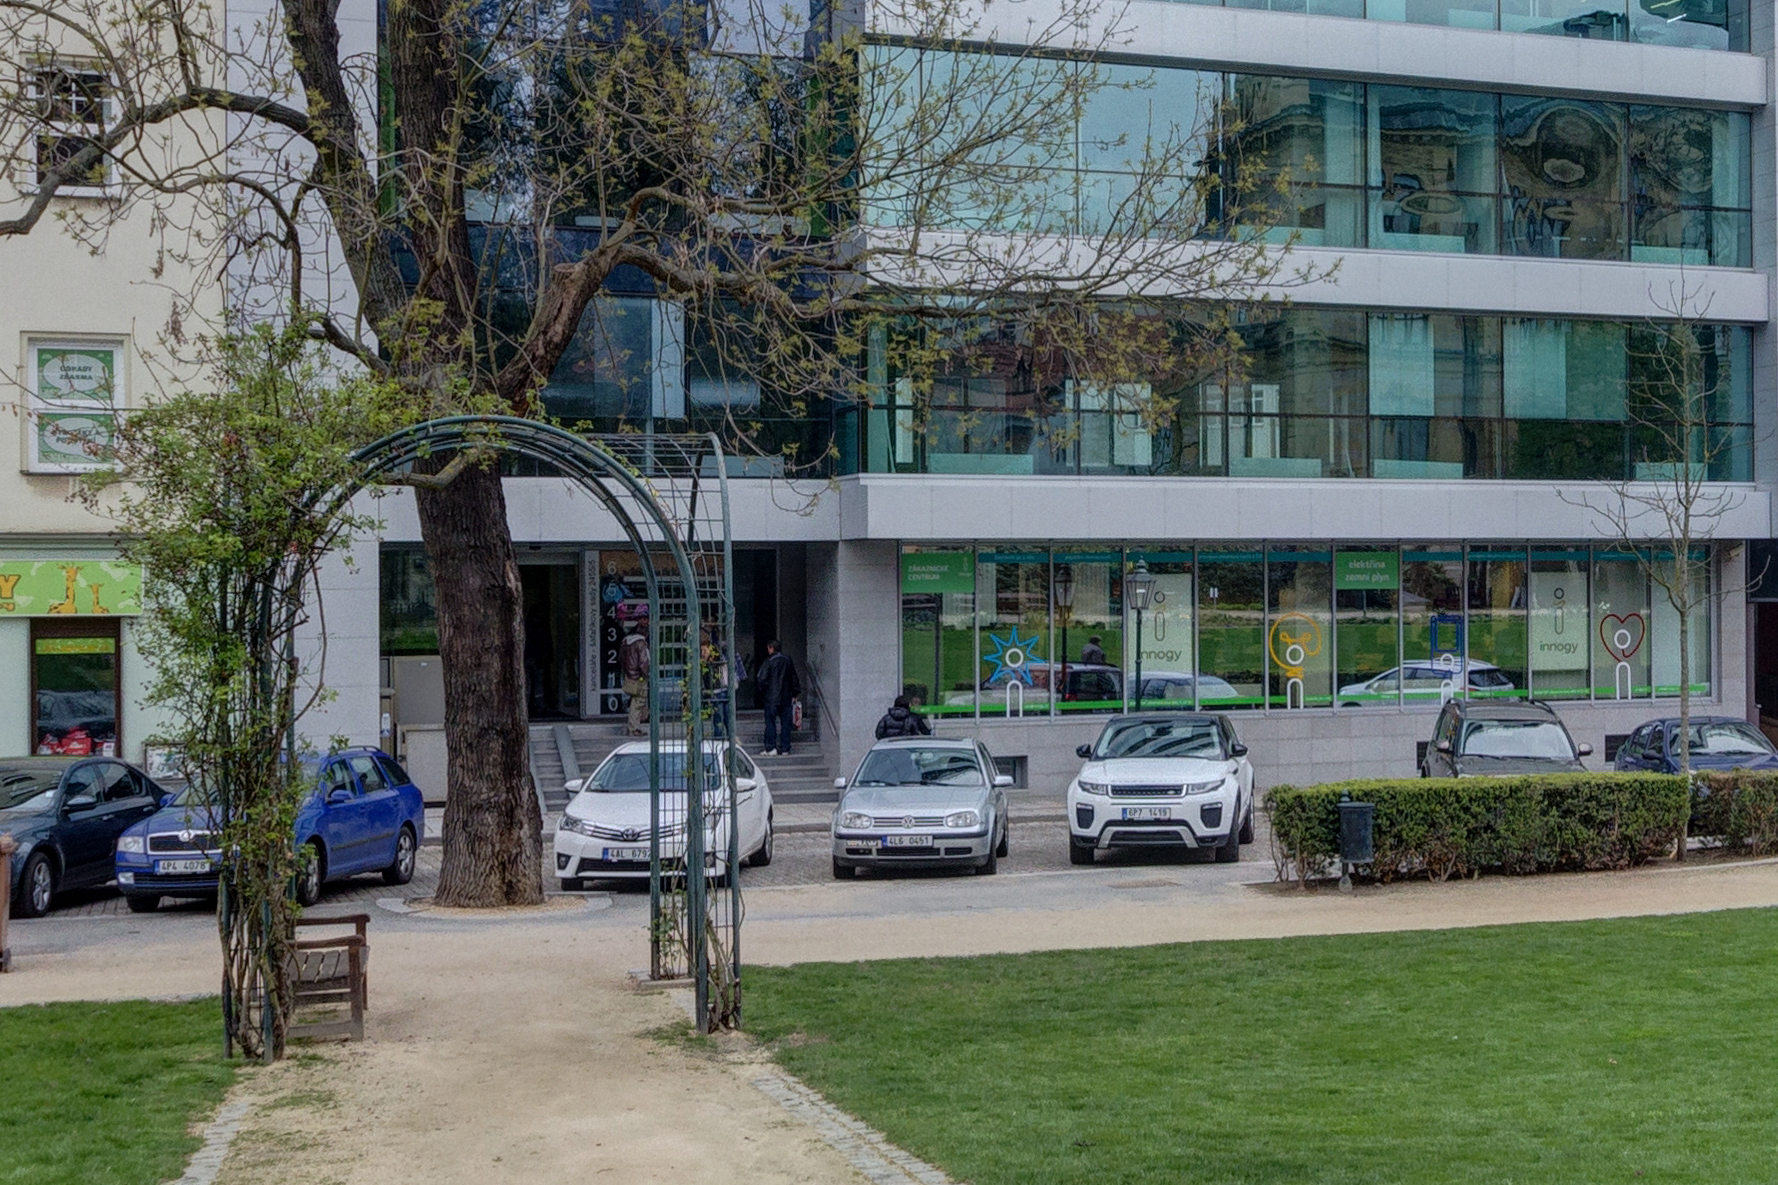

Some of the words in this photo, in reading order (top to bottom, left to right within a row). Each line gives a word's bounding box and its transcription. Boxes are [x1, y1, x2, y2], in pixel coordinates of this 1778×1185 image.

[607, 560, 617, 575] 6
[1348, 559, 1386, 569] elektřina
[1345, 573, 1370, 581] zemní
[1371, 572, 1390, 583] plyn
[606, 605, 616, 620] 4
[607, 627, 617, 642] 3
[1539, 640, 1578, 654] innogy
[607, 649, 617, 664] 2
[1140, 649, 1182, 663] nnogy
[608, 697, 619, 712] 0
[908, 836, 929, 845] 0451
[161, 862, 177, 871] 4P4
